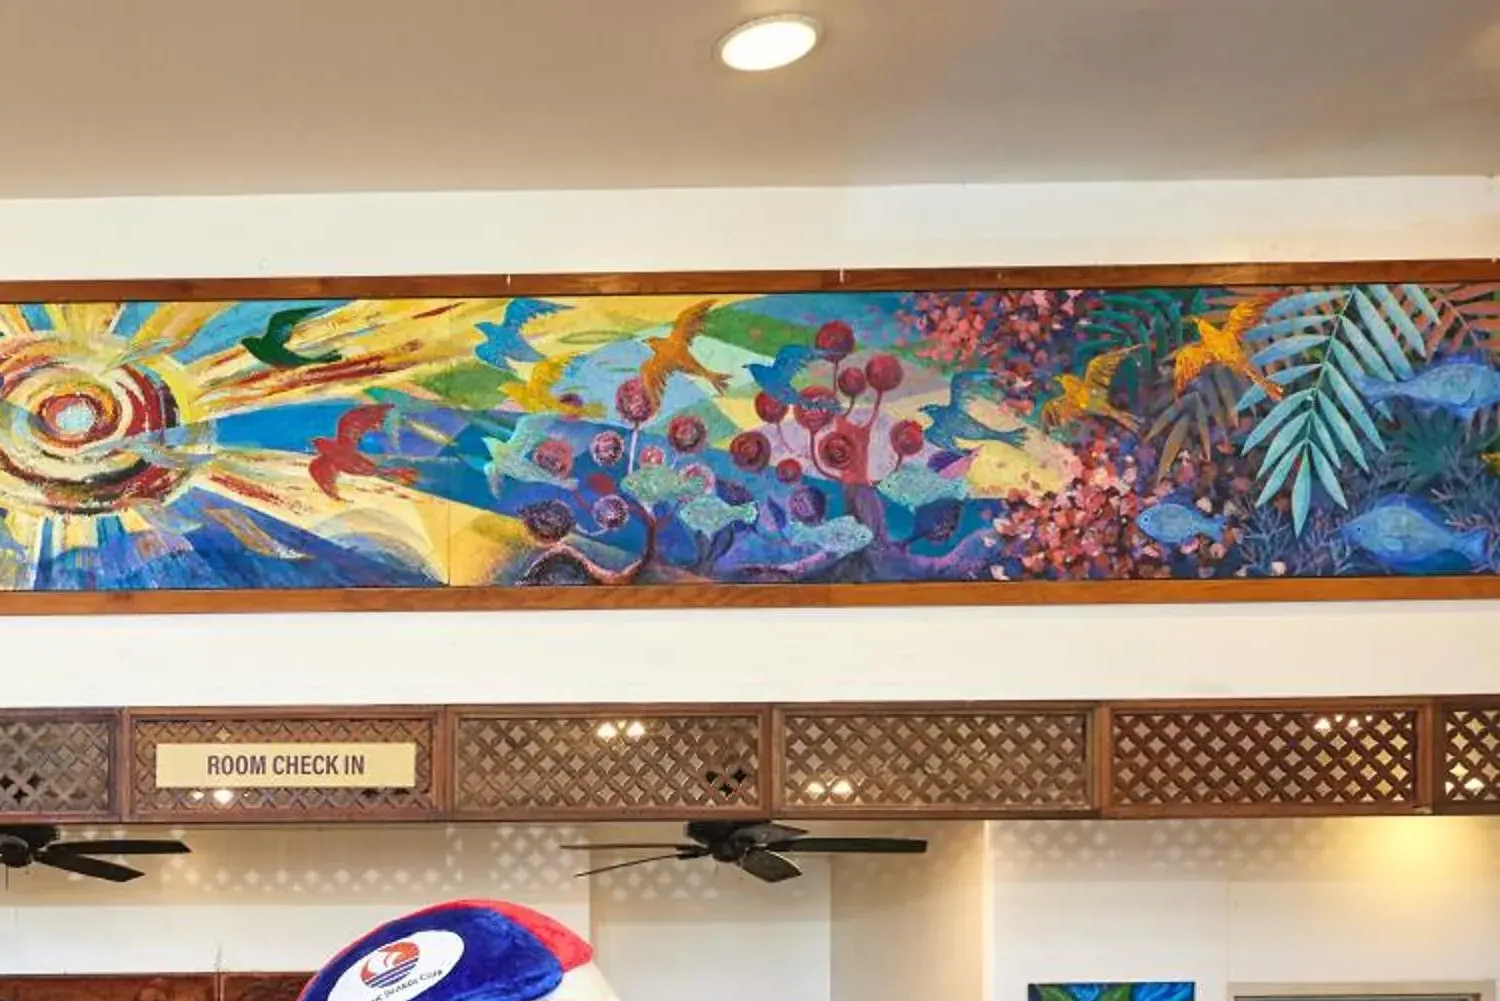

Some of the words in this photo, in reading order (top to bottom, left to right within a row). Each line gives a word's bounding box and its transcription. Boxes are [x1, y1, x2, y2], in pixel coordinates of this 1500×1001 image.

[207, 754, 266, 776] ROOM
[273, 754, 338, 775] CHECK
[344, 755, 365, 775] IN
